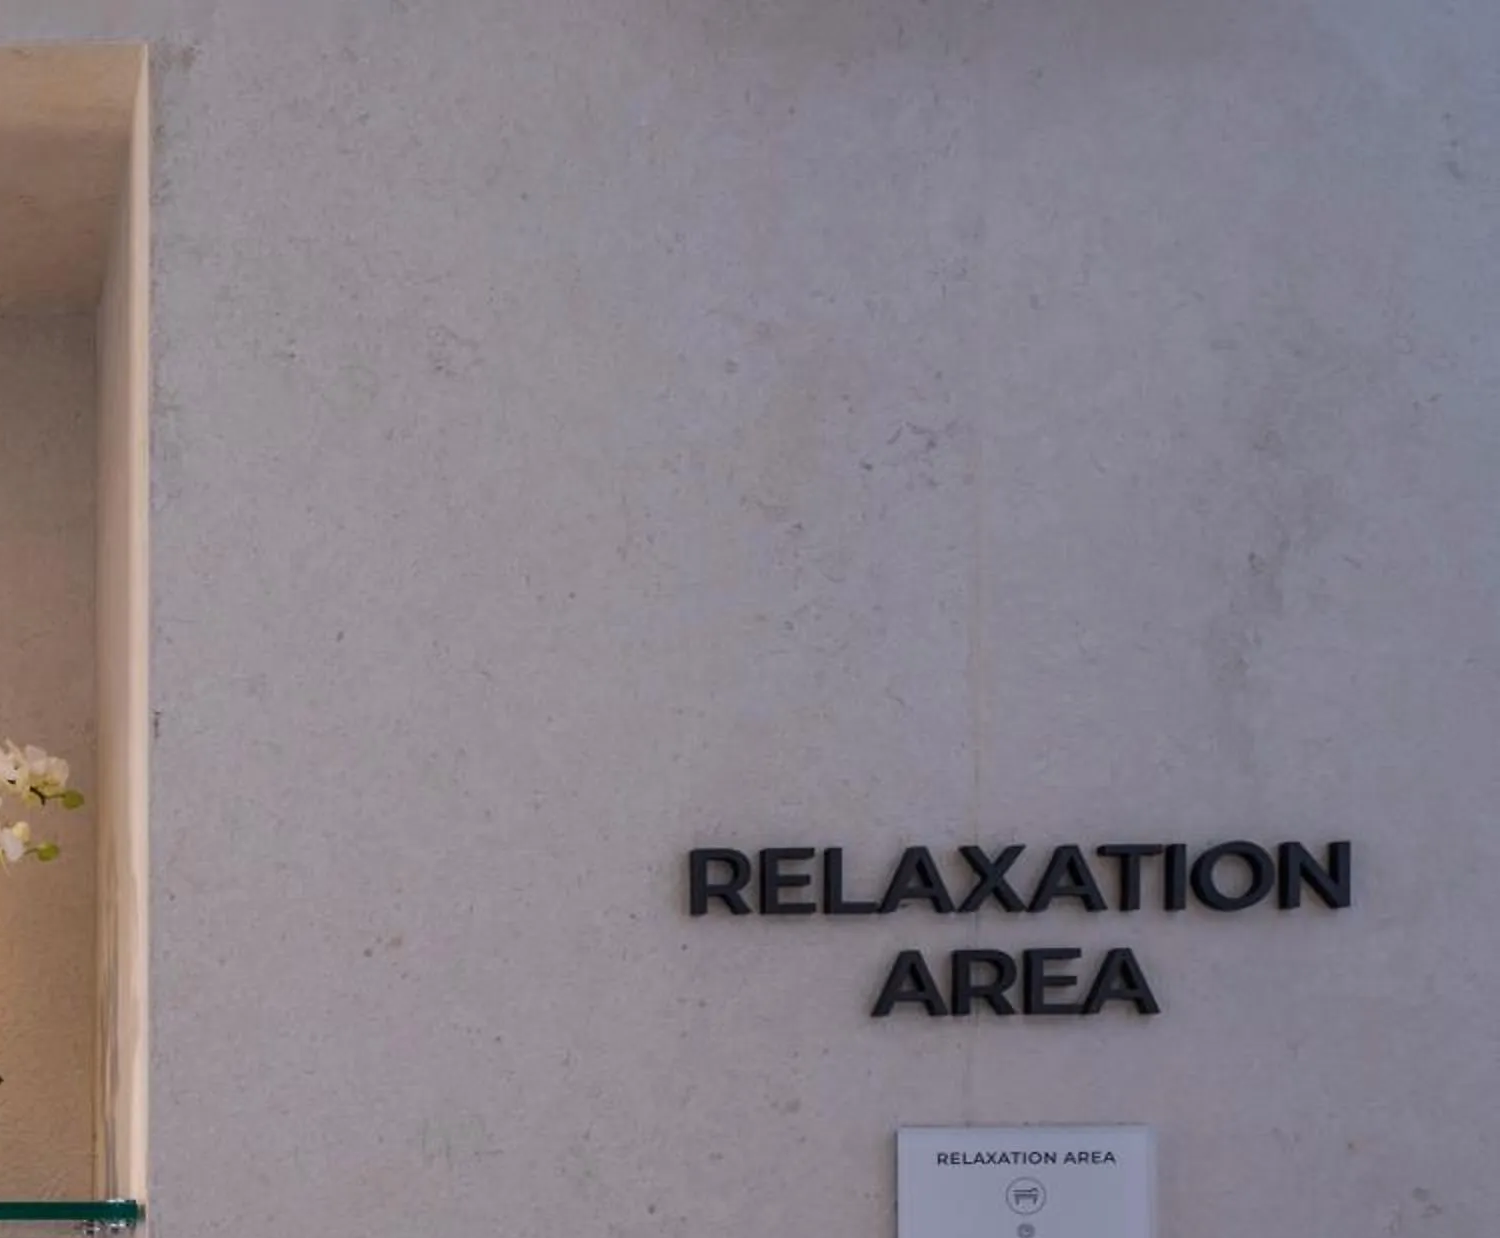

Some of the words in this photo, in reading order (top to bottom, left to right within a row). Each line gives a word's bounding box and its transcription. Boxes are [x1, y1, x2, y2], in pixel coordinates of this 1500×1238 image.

[688, 840, 1352, 916] RELAXATION
[870, 947, 1161, 1018] AREA
[936, 1151, 1057, 1166] RELAXATION
[1063, 1151, 1117, 1165] AREA
